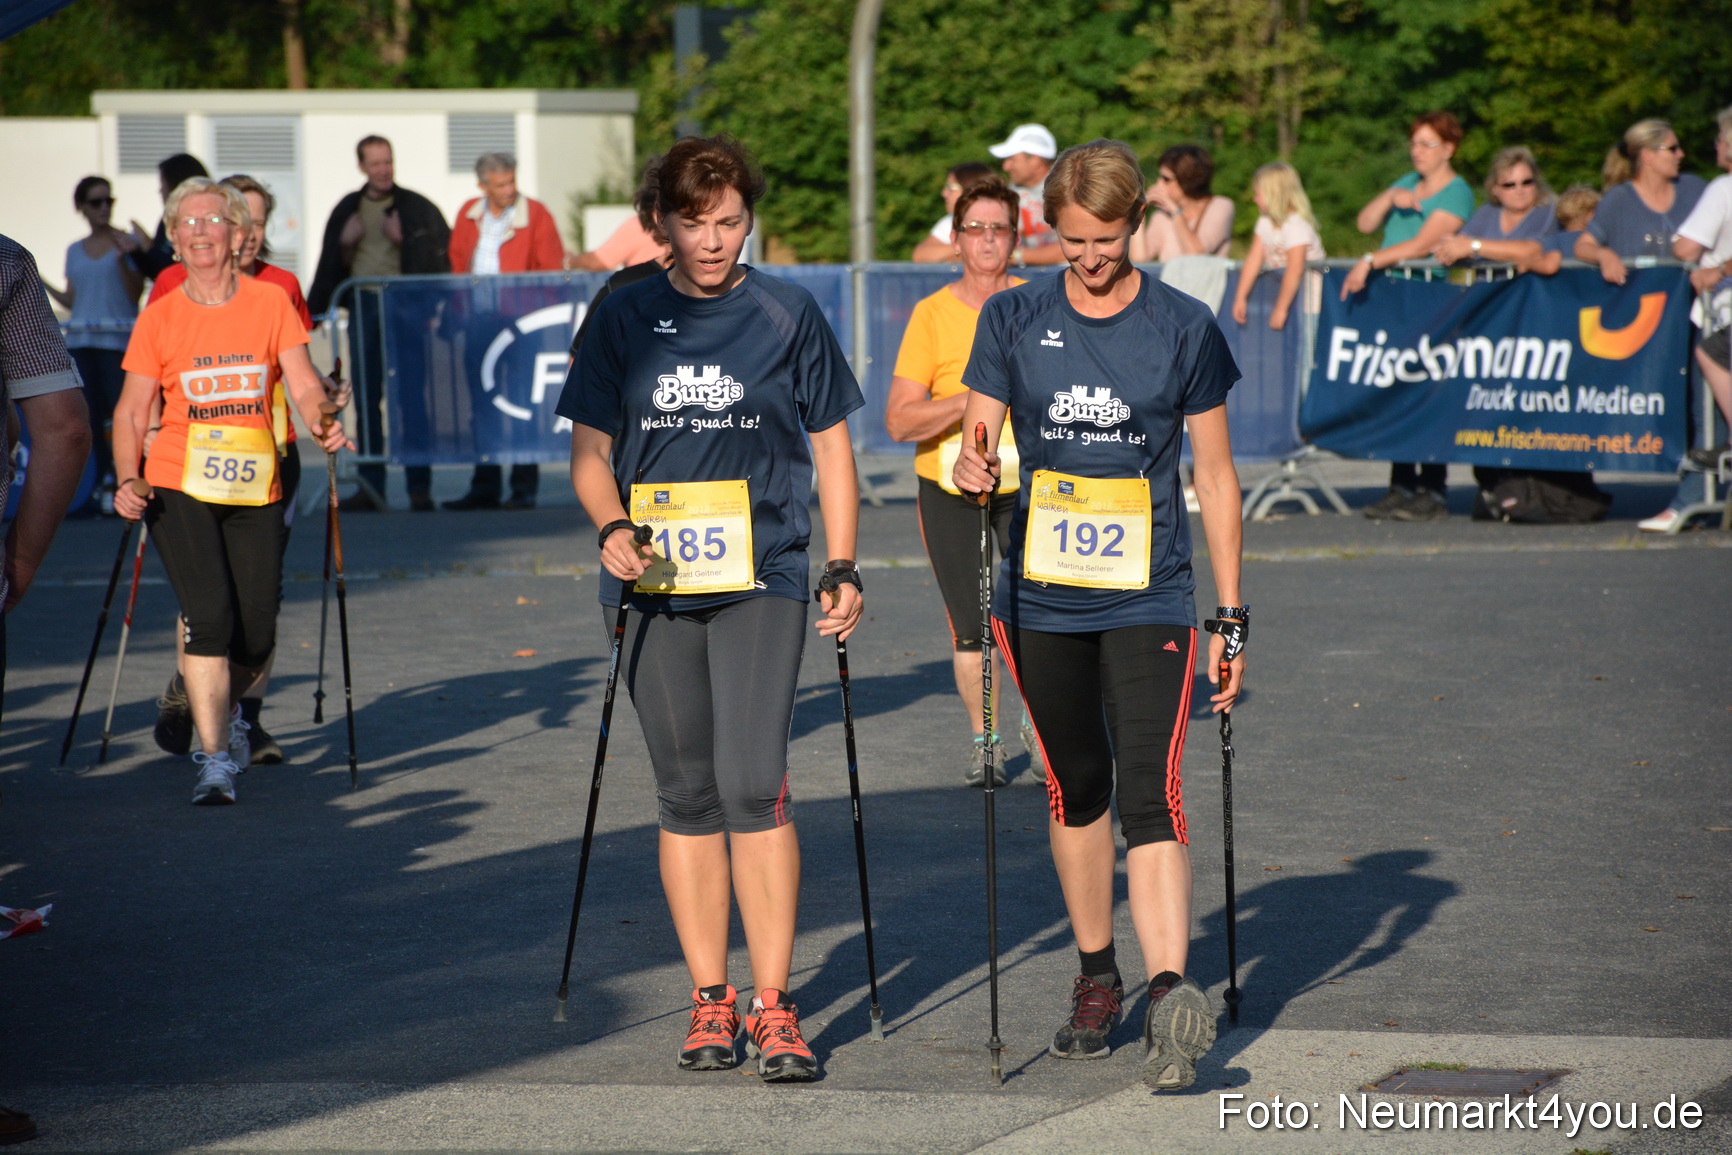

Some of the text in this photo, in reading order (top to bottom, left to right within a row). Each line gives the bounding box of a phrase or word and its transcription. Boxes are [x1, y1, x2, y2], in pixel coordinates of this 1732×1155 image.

[1040, 338, 1064, 348] erima
[193, 353, 254, 368] 30 Jahre
[1327, 326, 1573, 388] Frischmann
[188, 372, 262, 396] OBI
[653, 375, 743, 411] Burgis
[1049, 391, 1130, 427] Burgis
[1465, 383, 1665, 417] Druck und Medien
[641, 414, 760, 433] Weil's guad is!
[1081, 429, 1122, 445] guad
[1128, 432, 1146, 445] is!
[1455, 426, 1664, 455] www.frischmann-net.de
[203, 456, 257, 483] 585
[647, 502, 685, 511] firmenlauf
[1037, 501, 1069, 514] walken
[1049, 490, 1089, 505] firmenlauf
[636, 515, 667, 524] walken
[655, 527, 727, 562] 185
[1053, 519, 1125, 557] 192
[662, 569, 722, 580] Hildegard Geitner
[1057, 561, 1114, 573] Martina Sellerer
[1225, 625, 1242, 656] LEKI
